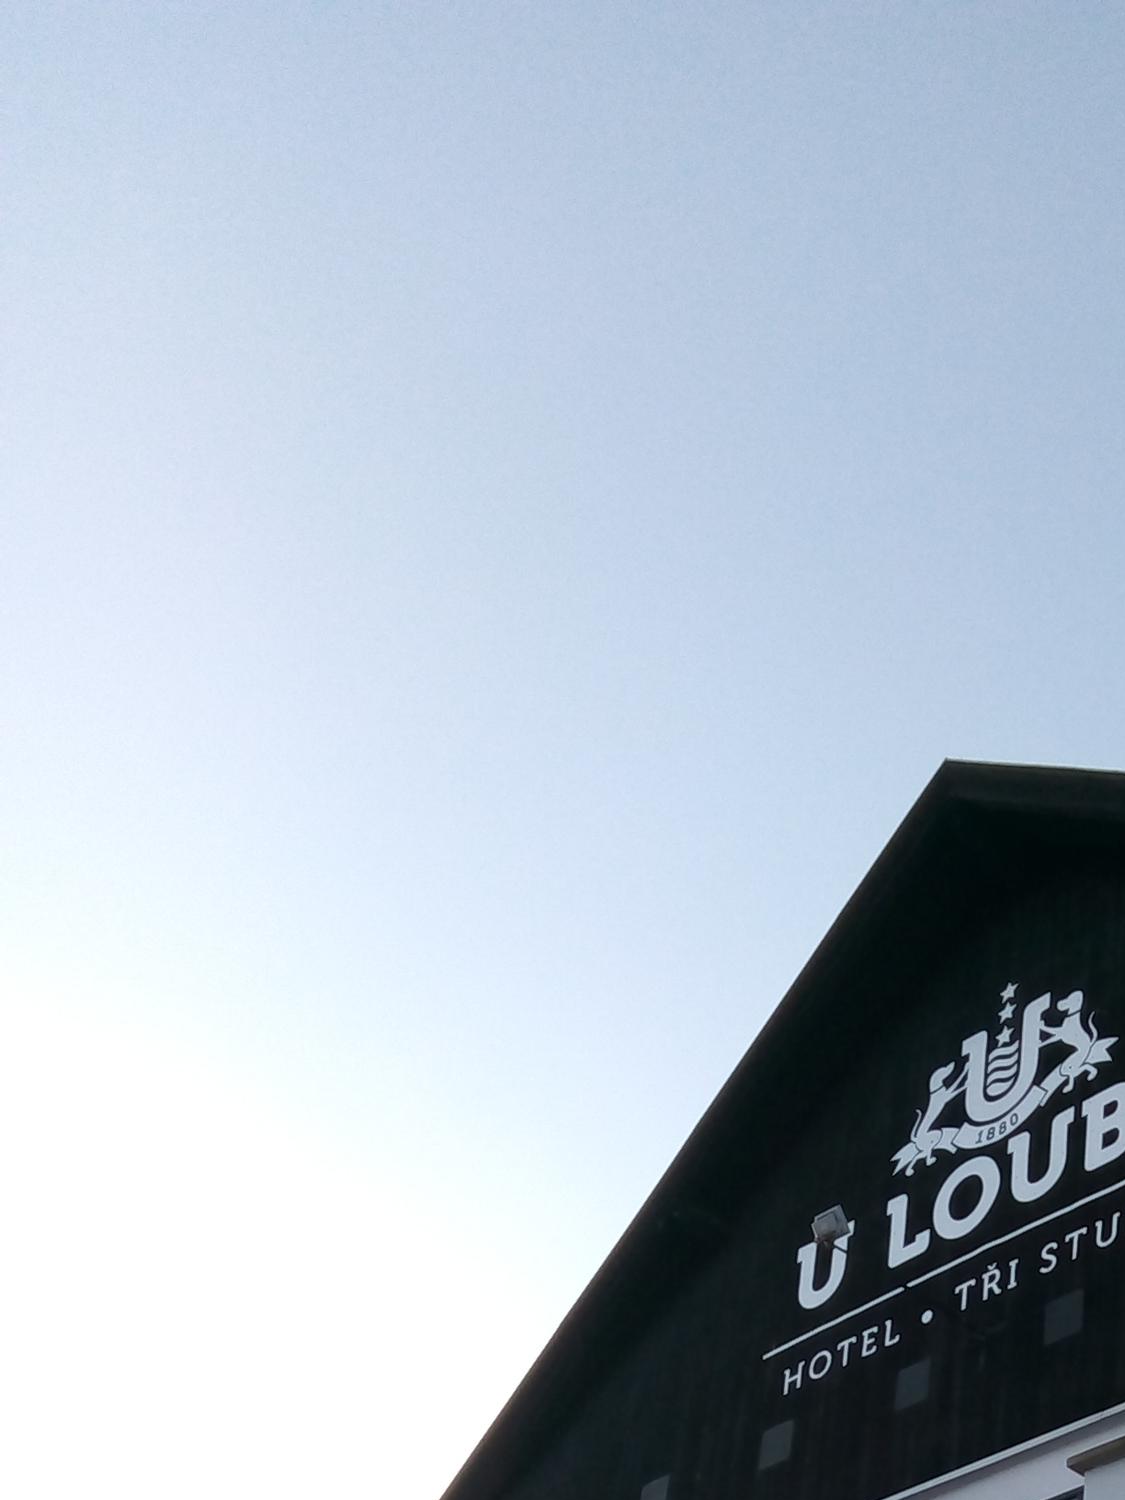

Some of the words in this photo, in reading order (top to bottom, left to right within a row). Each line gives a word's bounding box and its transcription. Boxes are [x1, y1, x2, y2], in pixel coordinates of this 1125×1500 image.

[975, 1112, 1020, 1145] 1880
[797, 1219, 856, 1310] U
[782, 1318, 901, 1395] HOTEL
[954, 1259, 1020, 1312] TŘI
